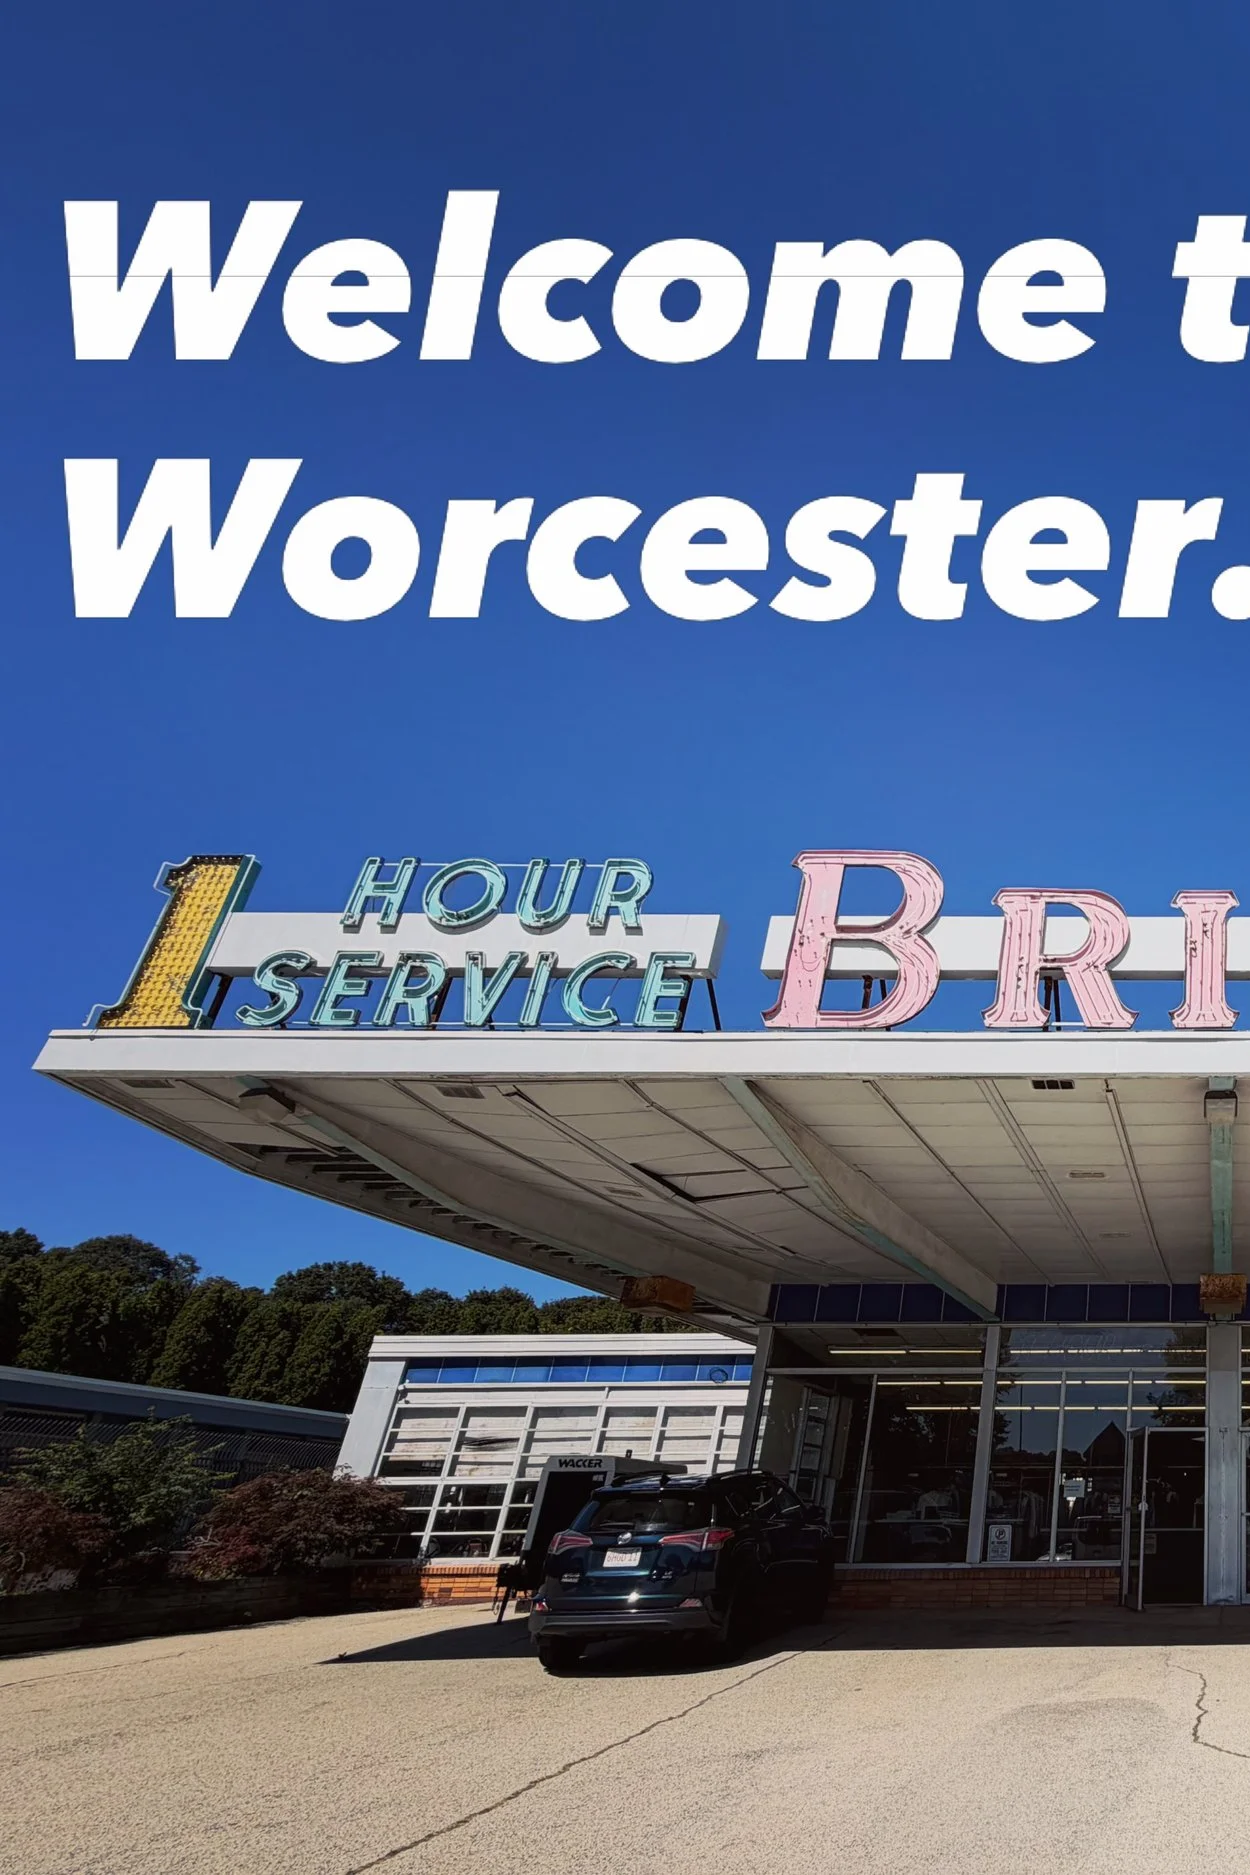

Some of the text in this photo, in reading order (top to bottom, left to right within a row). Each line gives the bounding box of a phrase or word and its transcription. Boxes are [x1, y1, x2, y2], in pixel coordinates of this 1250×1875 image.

[88, 854, 654, 1030] 1 HOUR
[235, 950, 697, 1028] SERVICE
[558, 1458, 603, 1468] WACKER
